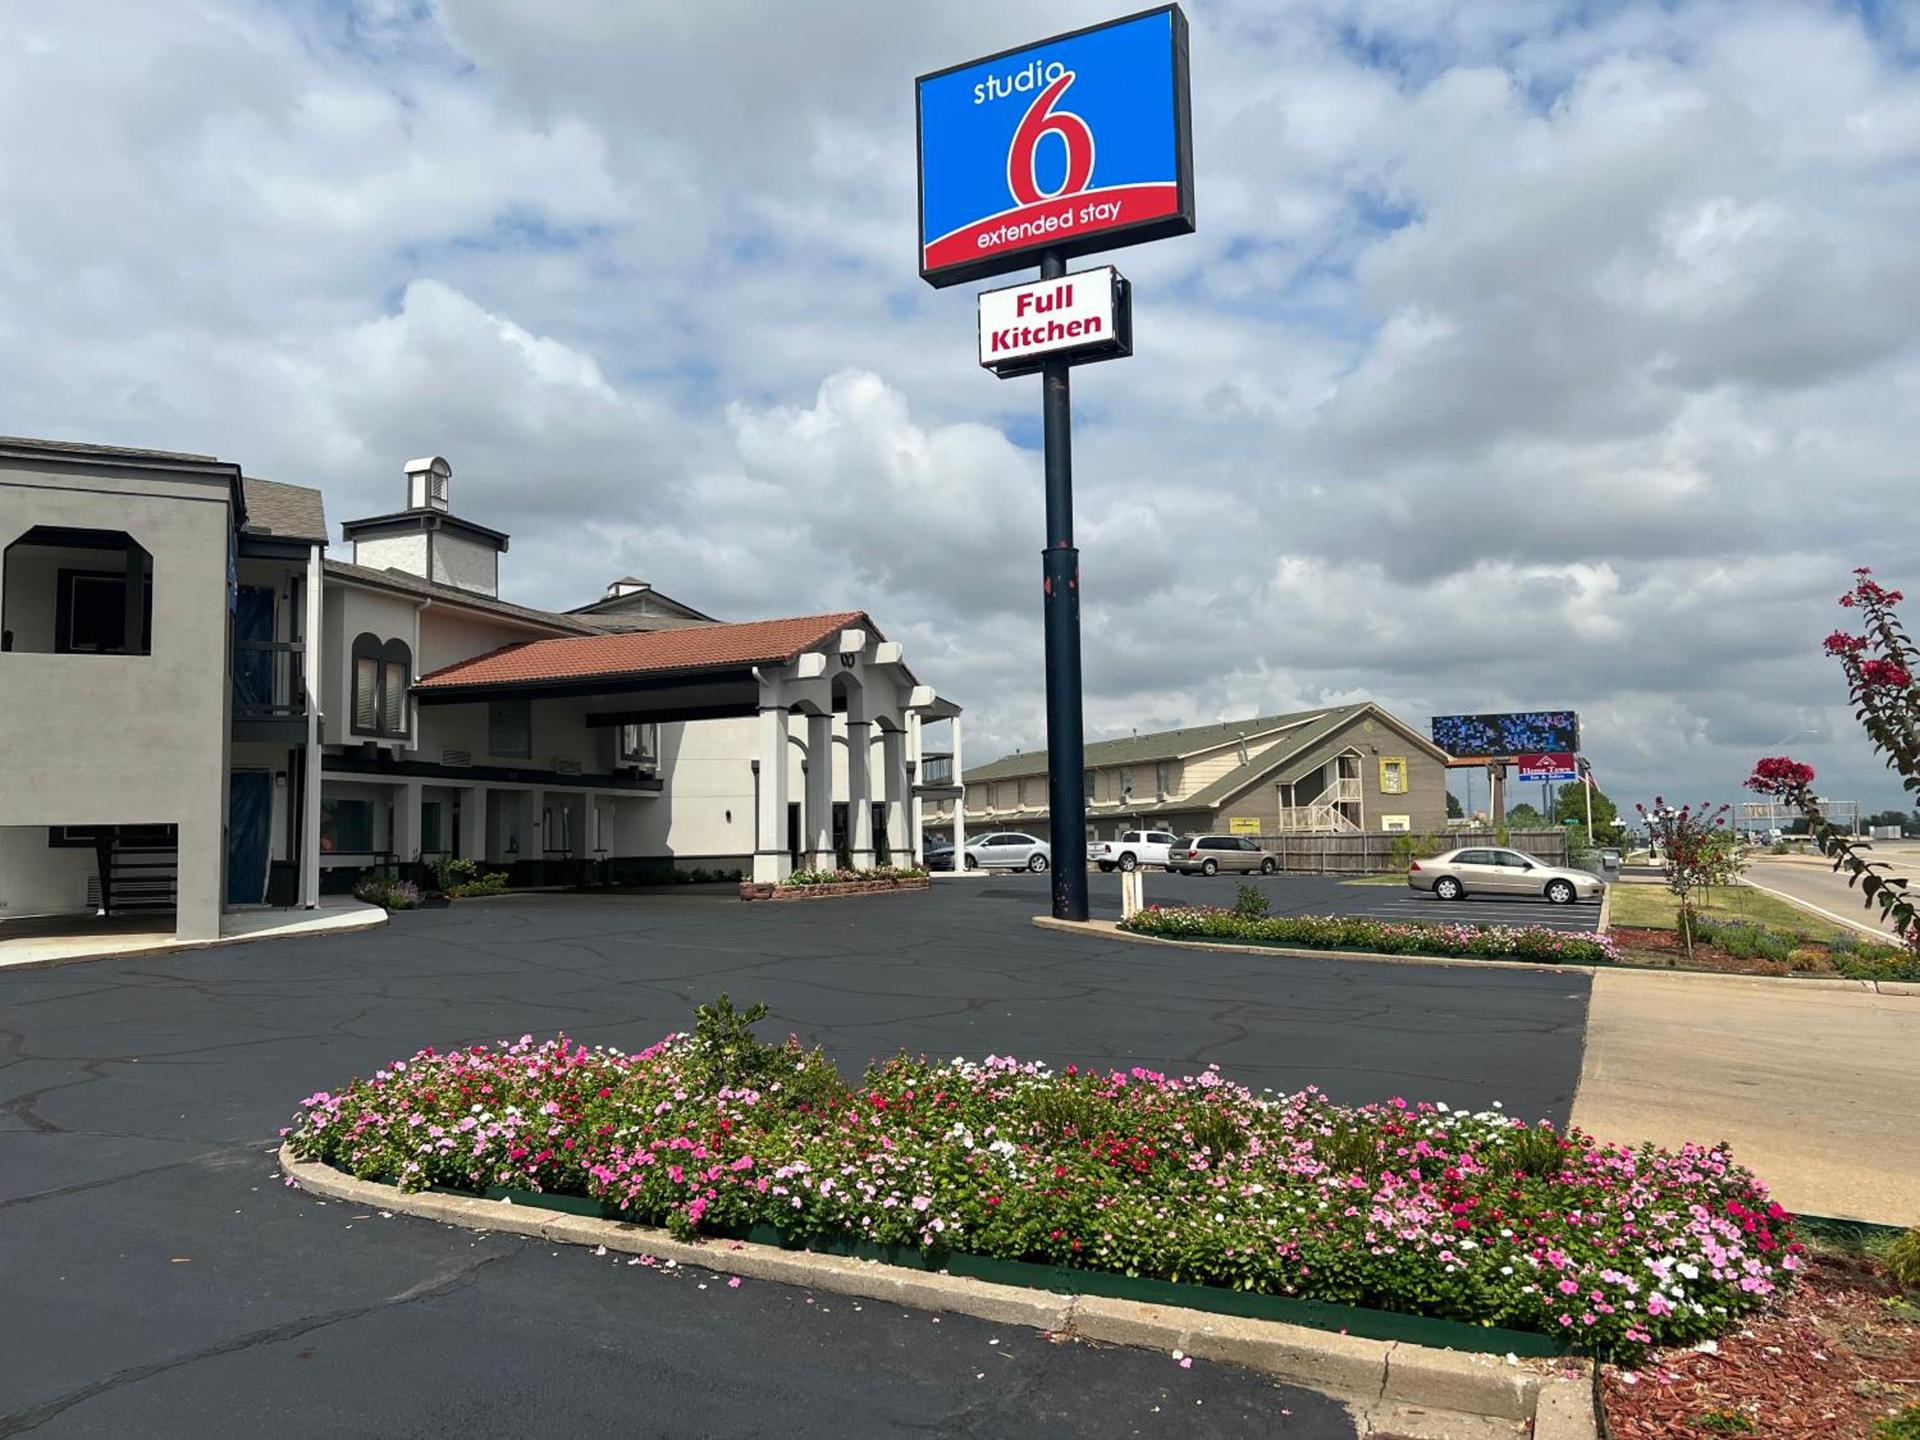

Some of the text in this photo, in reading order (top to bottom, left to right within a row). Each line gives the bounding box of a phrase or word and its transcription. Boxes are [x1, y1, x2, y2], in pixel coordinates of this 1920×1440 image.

[974, 60, 1065, 104] studio
[1007, 70, 1096, 208] 6
[977, 200, 1122, 248] extended stay
[1016, 284, 1073, 318] Full
[991, 315, 1102, 353] Kitchen
